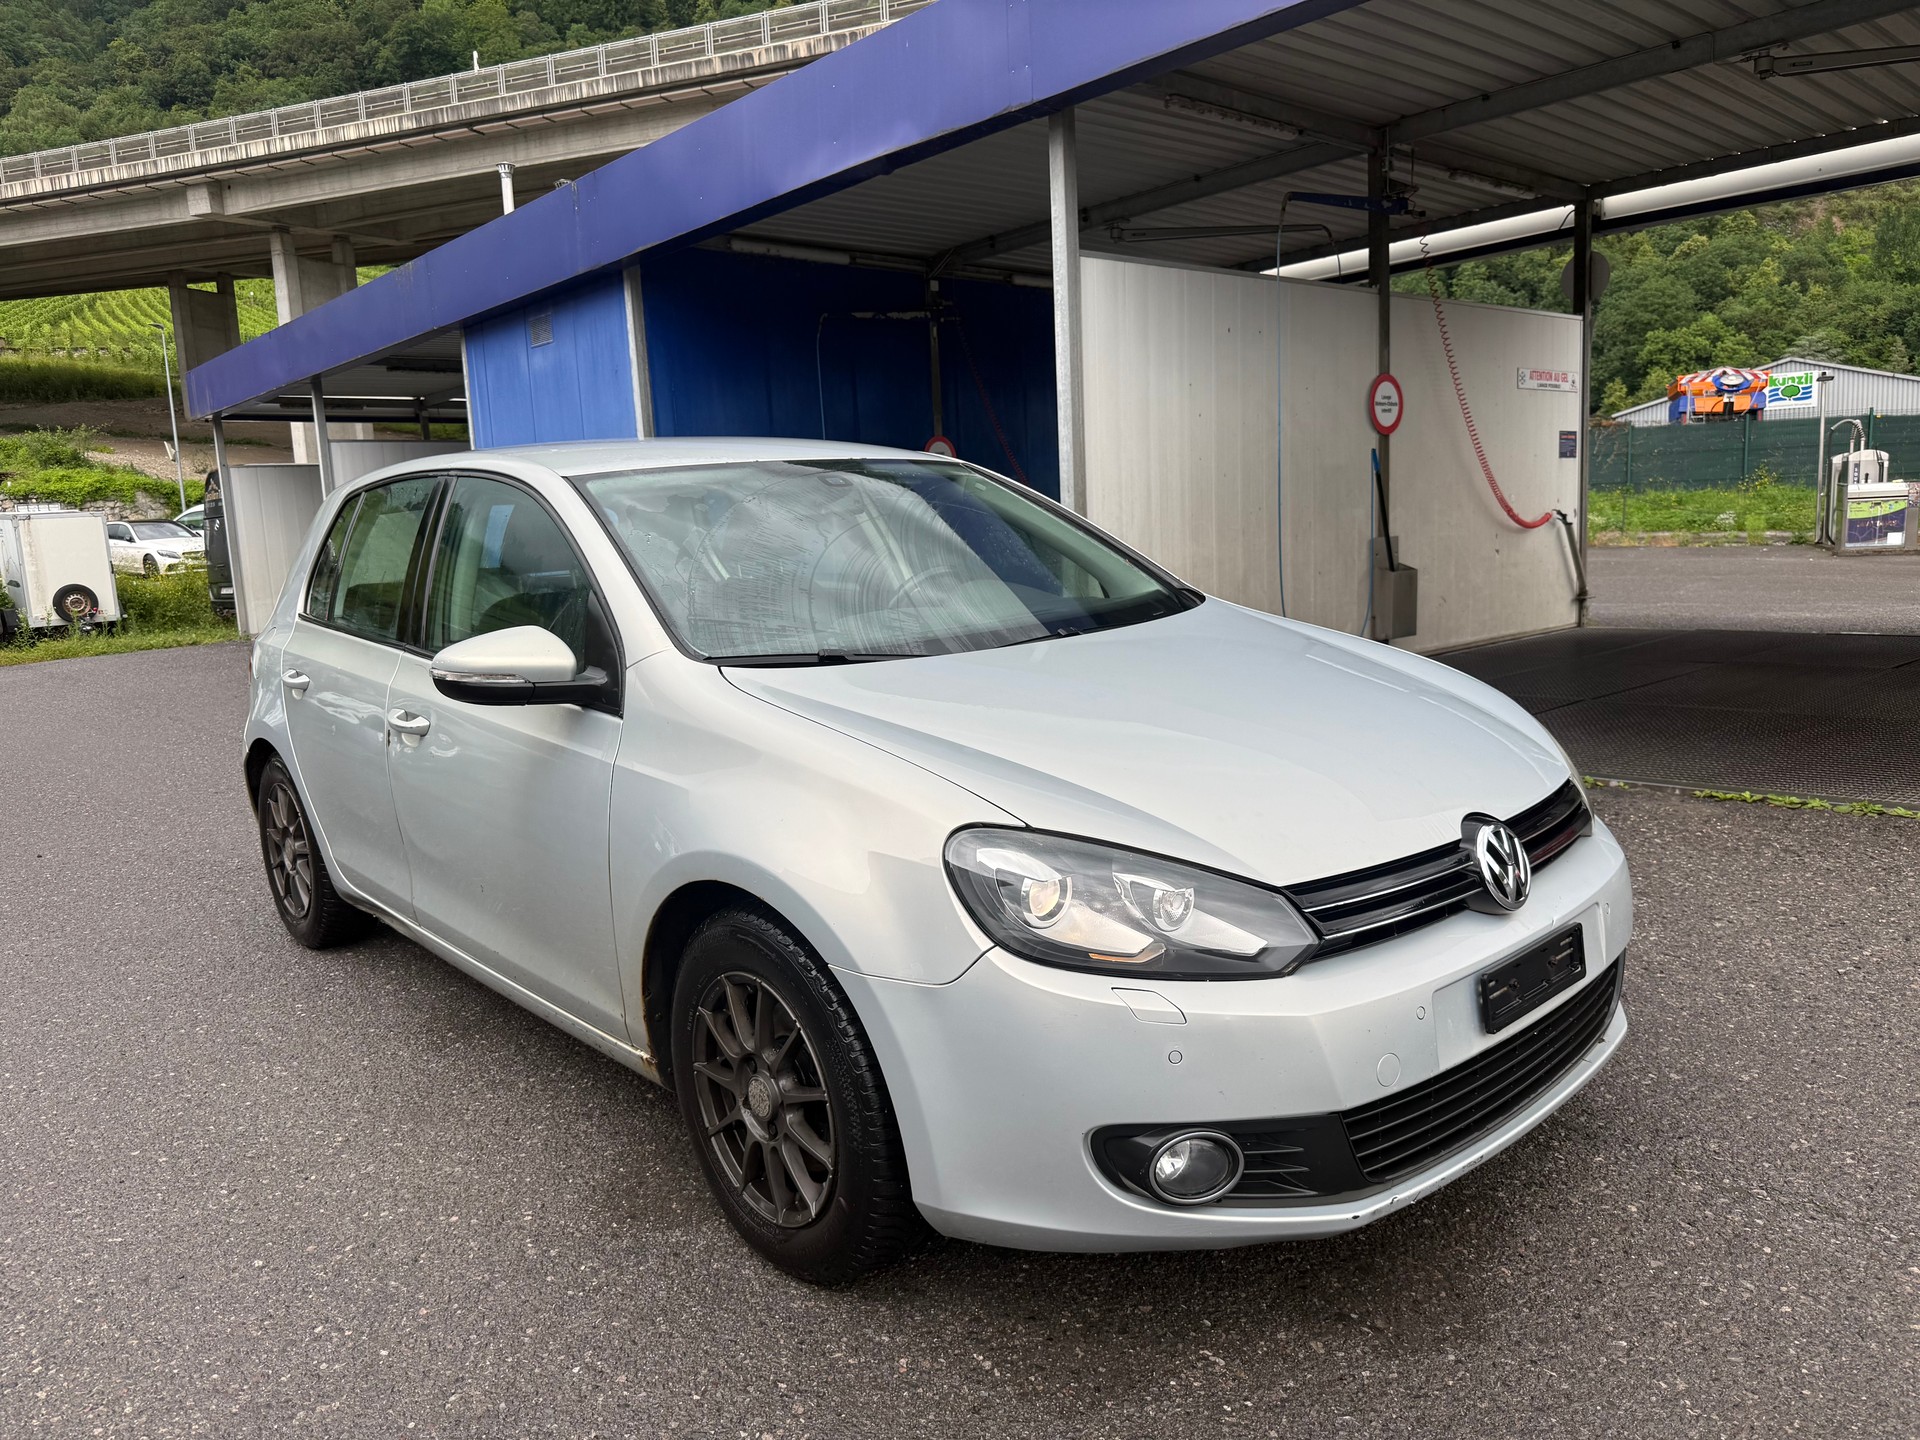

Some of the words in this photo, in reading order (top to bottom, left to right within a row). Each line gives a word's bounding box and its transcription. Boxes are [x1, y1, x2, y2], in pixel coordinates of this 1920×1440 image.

[1529, 370, 1553, 381] ATTENTION
[1554, 372, 1560, 382] AU
[1561, 373, 1569, 383] GEL
